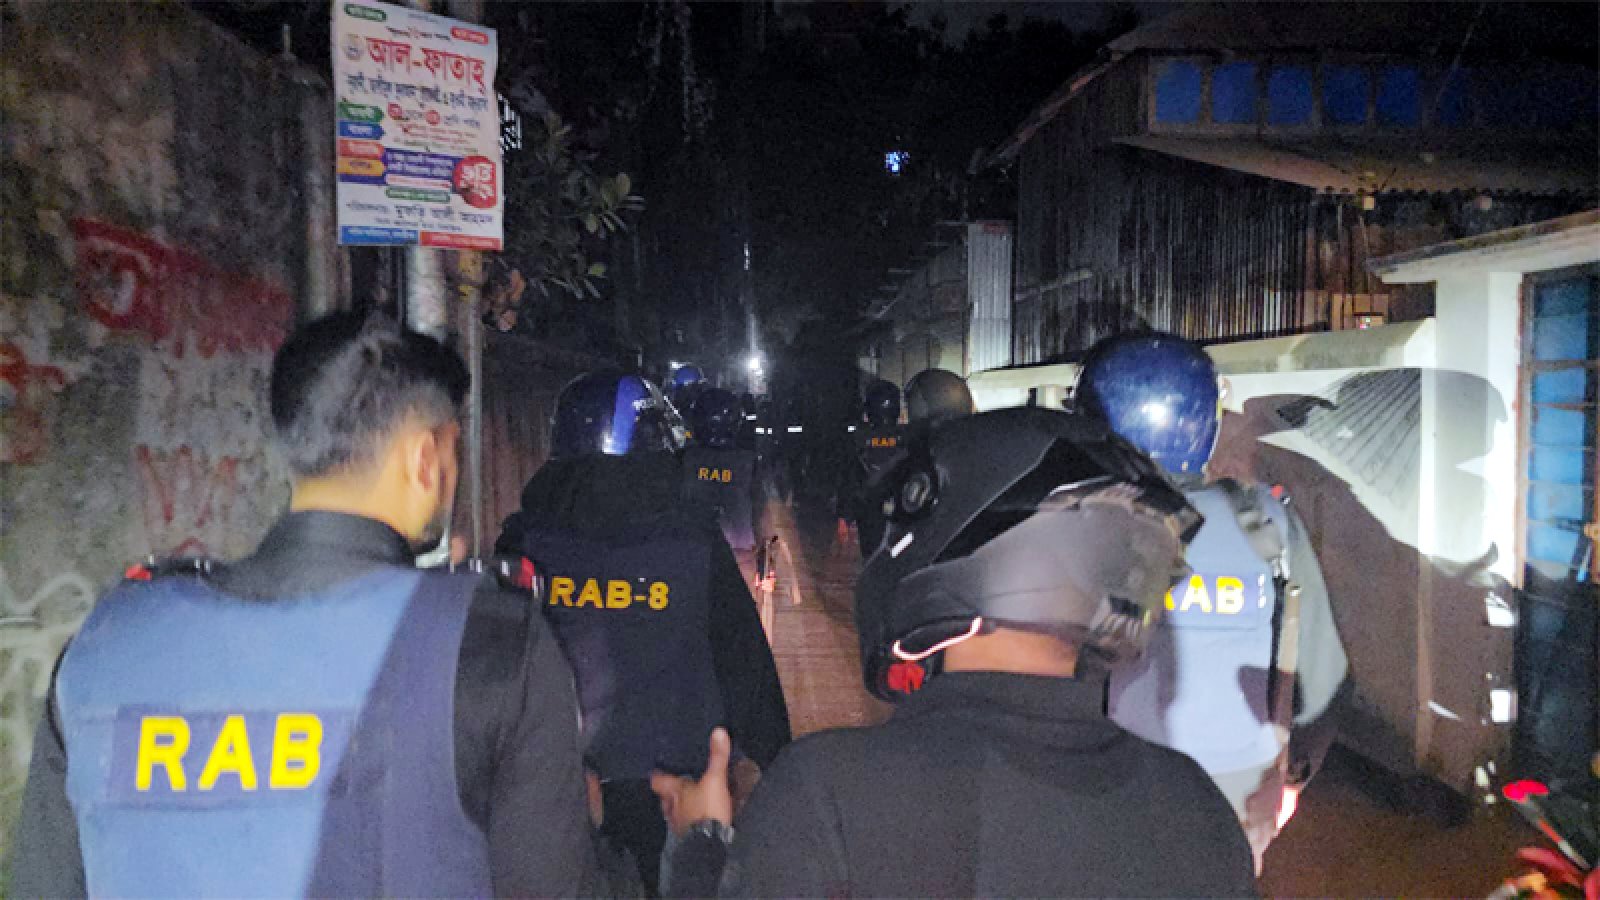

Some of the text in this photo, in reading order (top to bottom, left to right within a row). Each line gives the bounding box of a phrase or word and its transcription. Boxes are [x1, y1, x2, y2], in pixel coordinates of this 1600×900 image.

[871, 437, 897, 448] RAB
[698, 467, 732, 482] RAB
[549, 576, 670, 611] RAB-8
[136, 712, 324, 791] RAB
